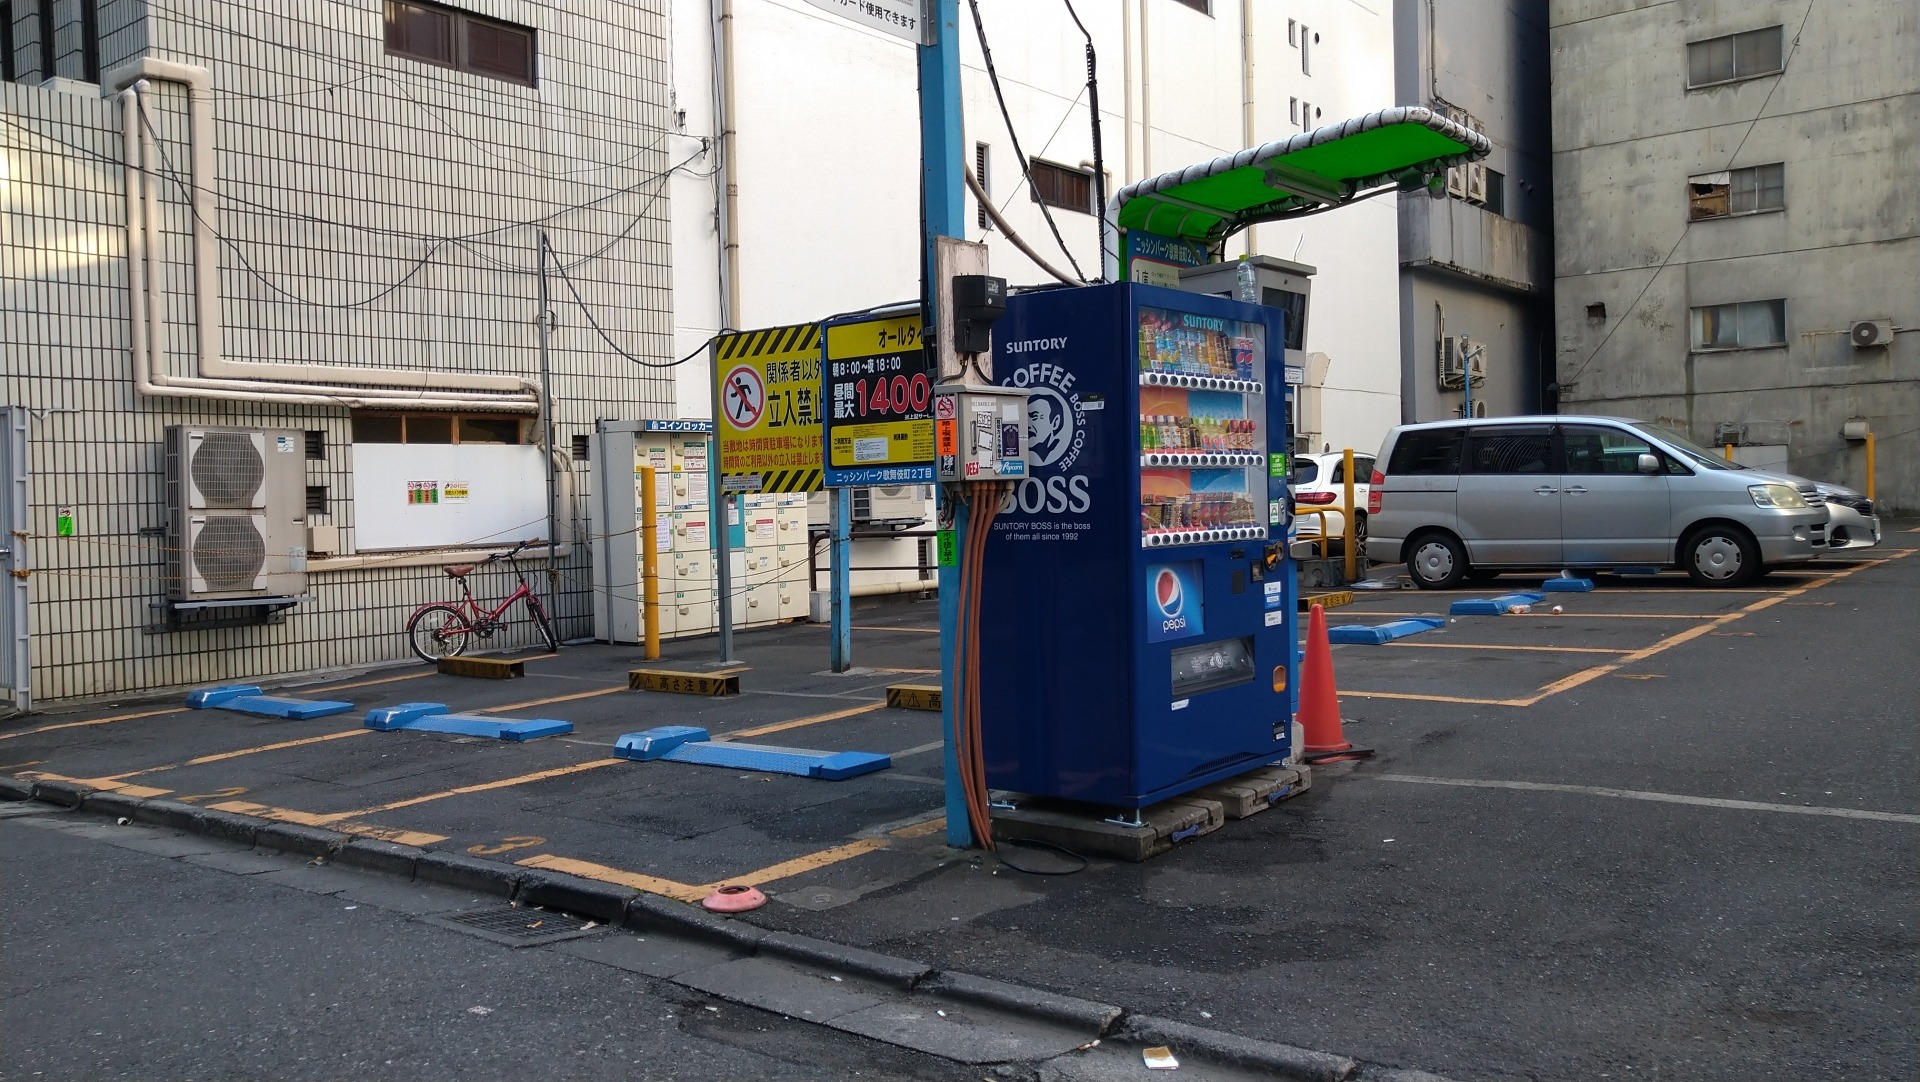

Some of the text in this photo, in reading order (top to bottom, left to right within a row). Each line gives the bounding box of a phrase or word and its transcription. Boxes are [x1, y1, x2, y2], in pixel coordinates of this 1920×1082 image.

[1006, 336, 1068, 354] SUNTORY
[855, 372, 930, 417] 1400
[834, 400, 855, 419] 最大
[659, 421, 713, 431] コインロッカー
[993, 522, 1091, 531] SUNTORY BOSS is the boss
[1005, 532, 1079, 541] of them all since 1992
[1162, 615, 1187, 633] pepsi
[659, 677, 708, 692] 高さ注意
